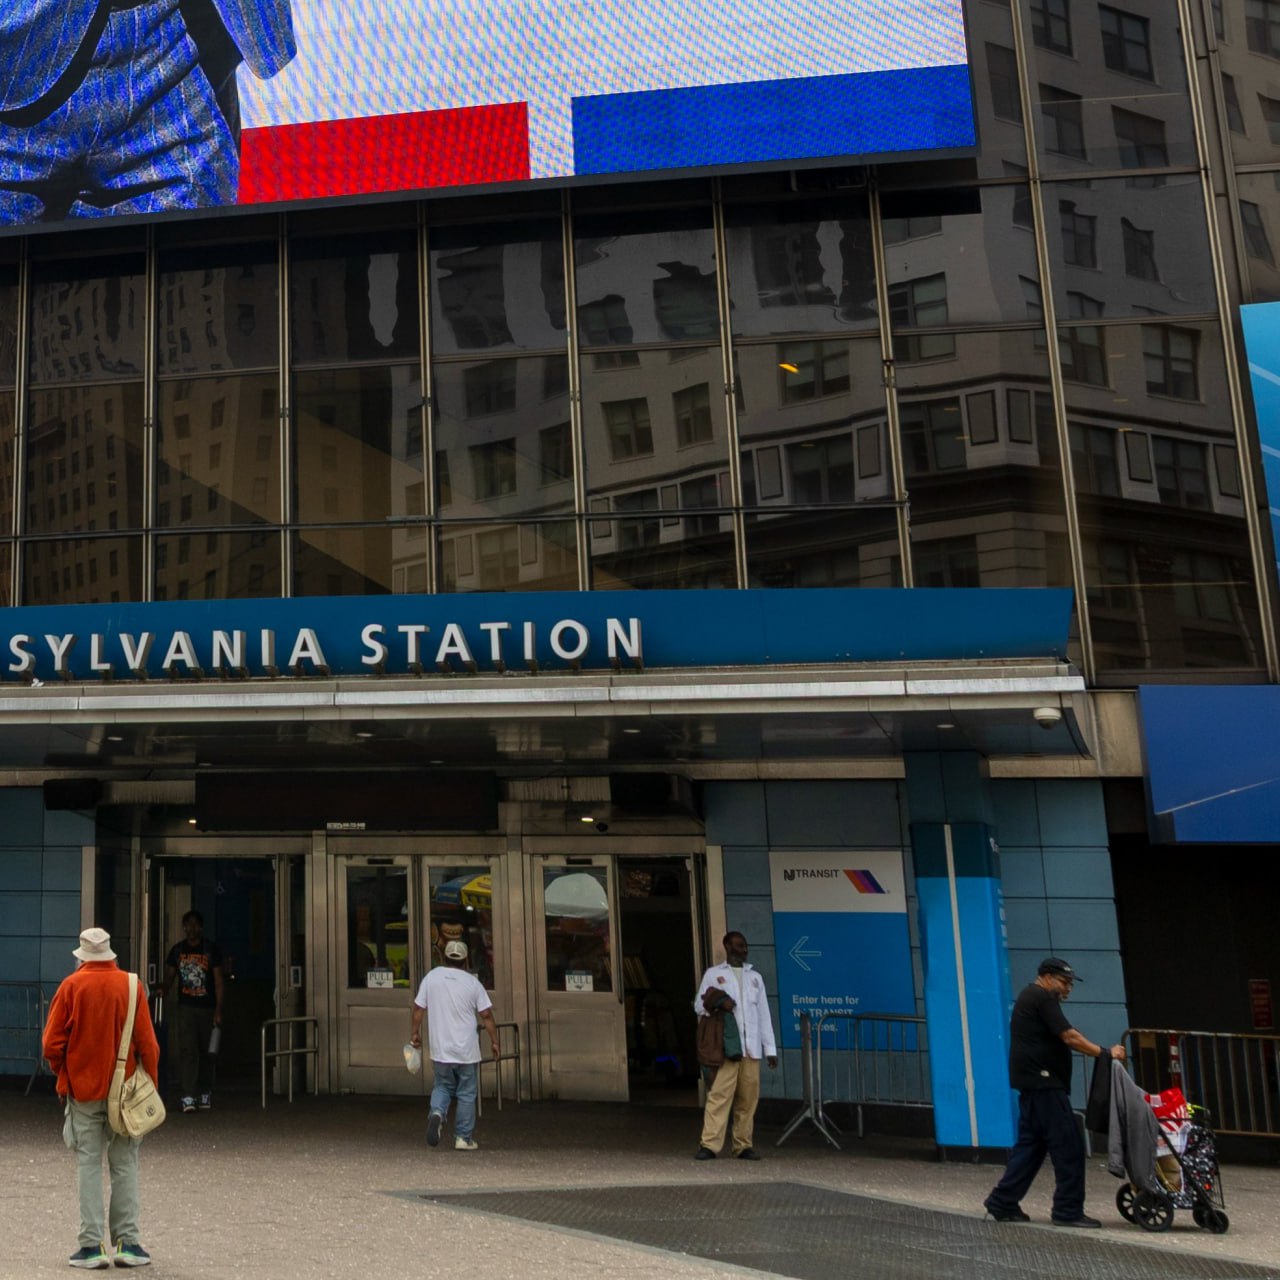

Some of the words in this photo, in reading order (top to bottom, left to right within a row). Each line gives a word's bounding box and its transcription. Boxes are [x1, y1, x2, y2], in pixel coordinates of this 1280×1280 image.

[361, 616, 644, 670] STATION
[795, 869, 840, 878] TRANSIT
[369, 972, 393, 981] PULL
[567, 975, 592, 984] PULL
[792, 994, 818, 1004] Enter
[821, 995, 843, 1005] here
[845, 995, 859, 1005] for
